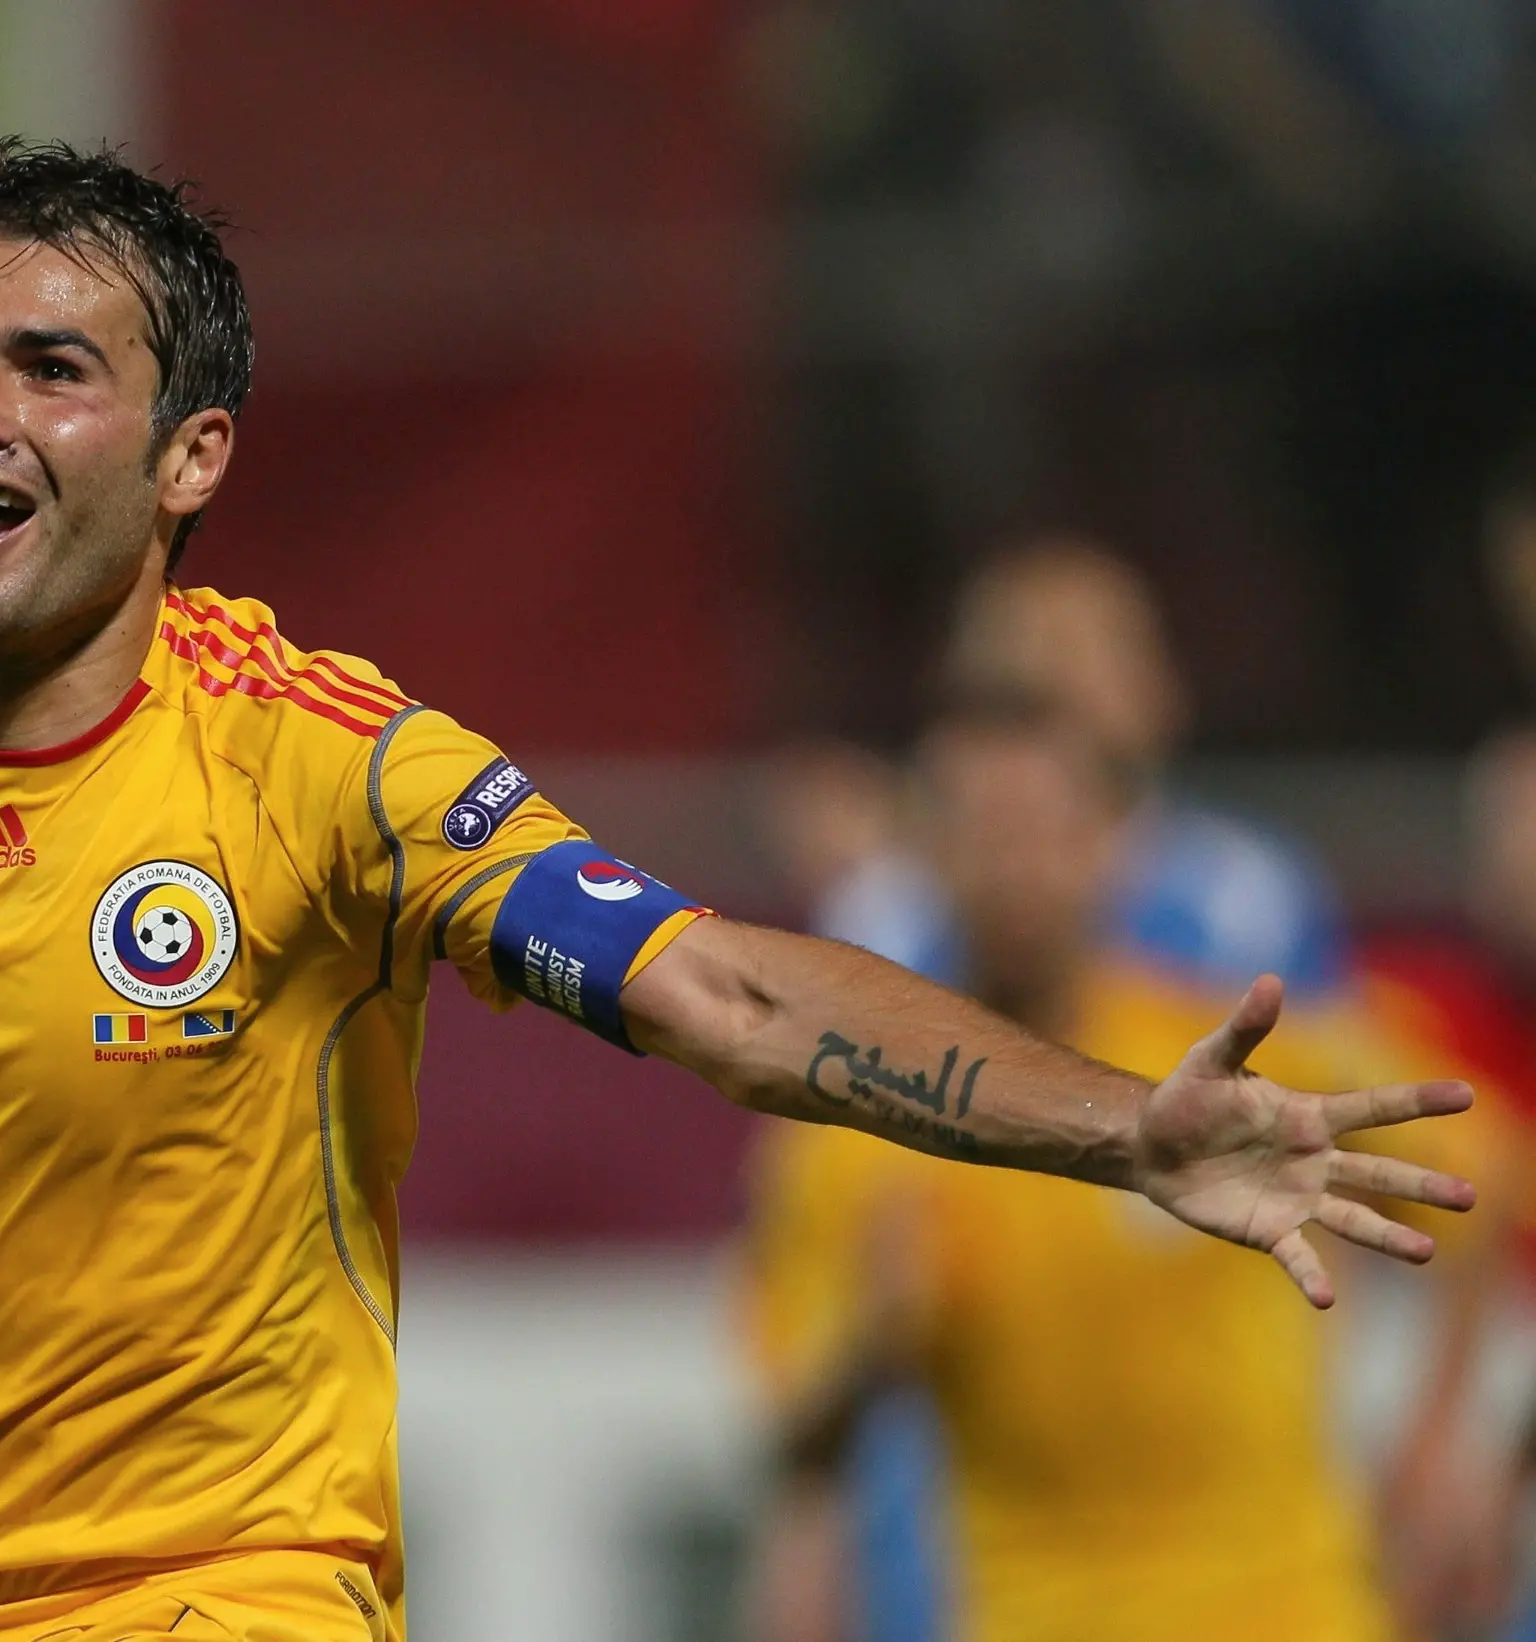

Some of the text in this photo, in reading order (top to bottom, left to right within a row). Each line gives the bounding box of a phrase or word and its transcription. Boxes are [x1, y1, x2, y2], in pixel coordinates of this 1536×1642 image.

[97, 868, 231, 942] FEDERATIA ROMANA DE FOTBAL
[107, 962, 221, 1000] FONDATA IN ANUL 1909
[524, 934, 548, 998] UNITE
